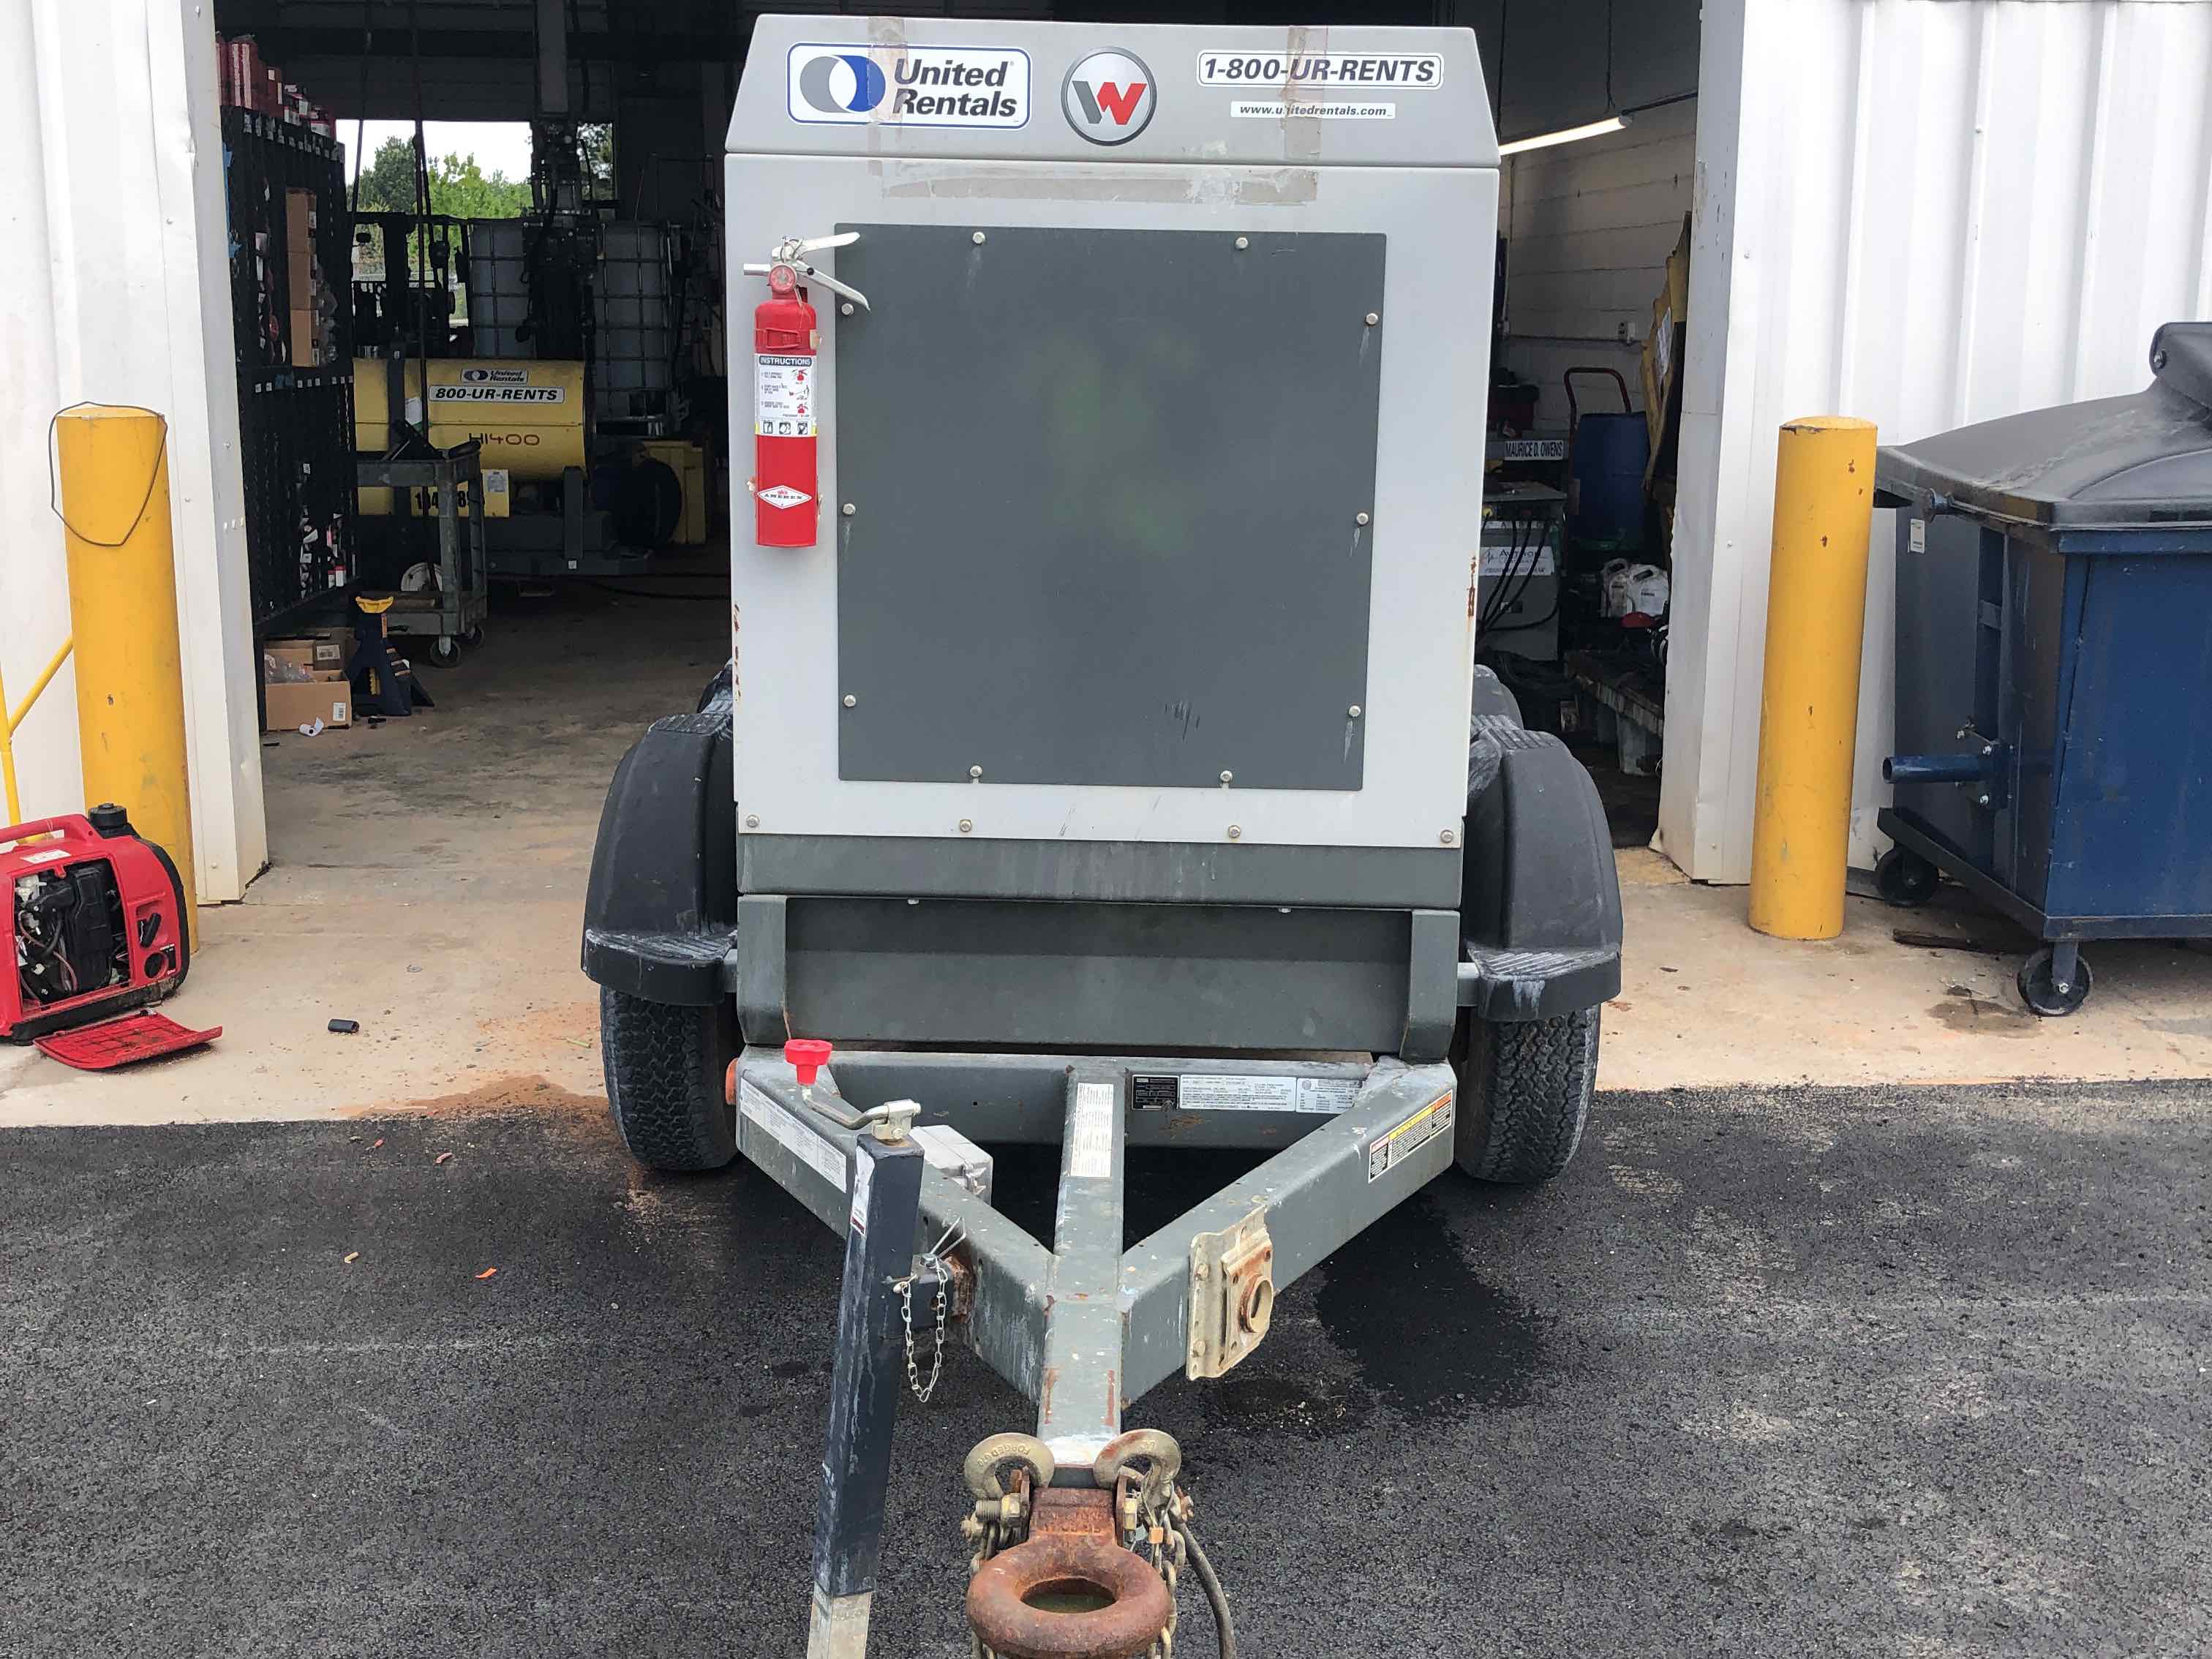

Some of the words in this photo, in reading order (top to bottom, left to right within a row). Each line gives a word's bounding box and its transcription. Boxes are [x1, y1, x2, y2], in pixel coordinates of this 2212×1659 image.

[894, 58, 1009, 87] United
[1205, 58, 1435, 82] 1-800-UR-RENTS
[892, 88, 1017, 117] Rentals
[435, 388, 557, 400] 800-UR-RENTS
[1505, 442, 1533, 457] MAURICE
[1540, 441, 1562, 457] OWENS
